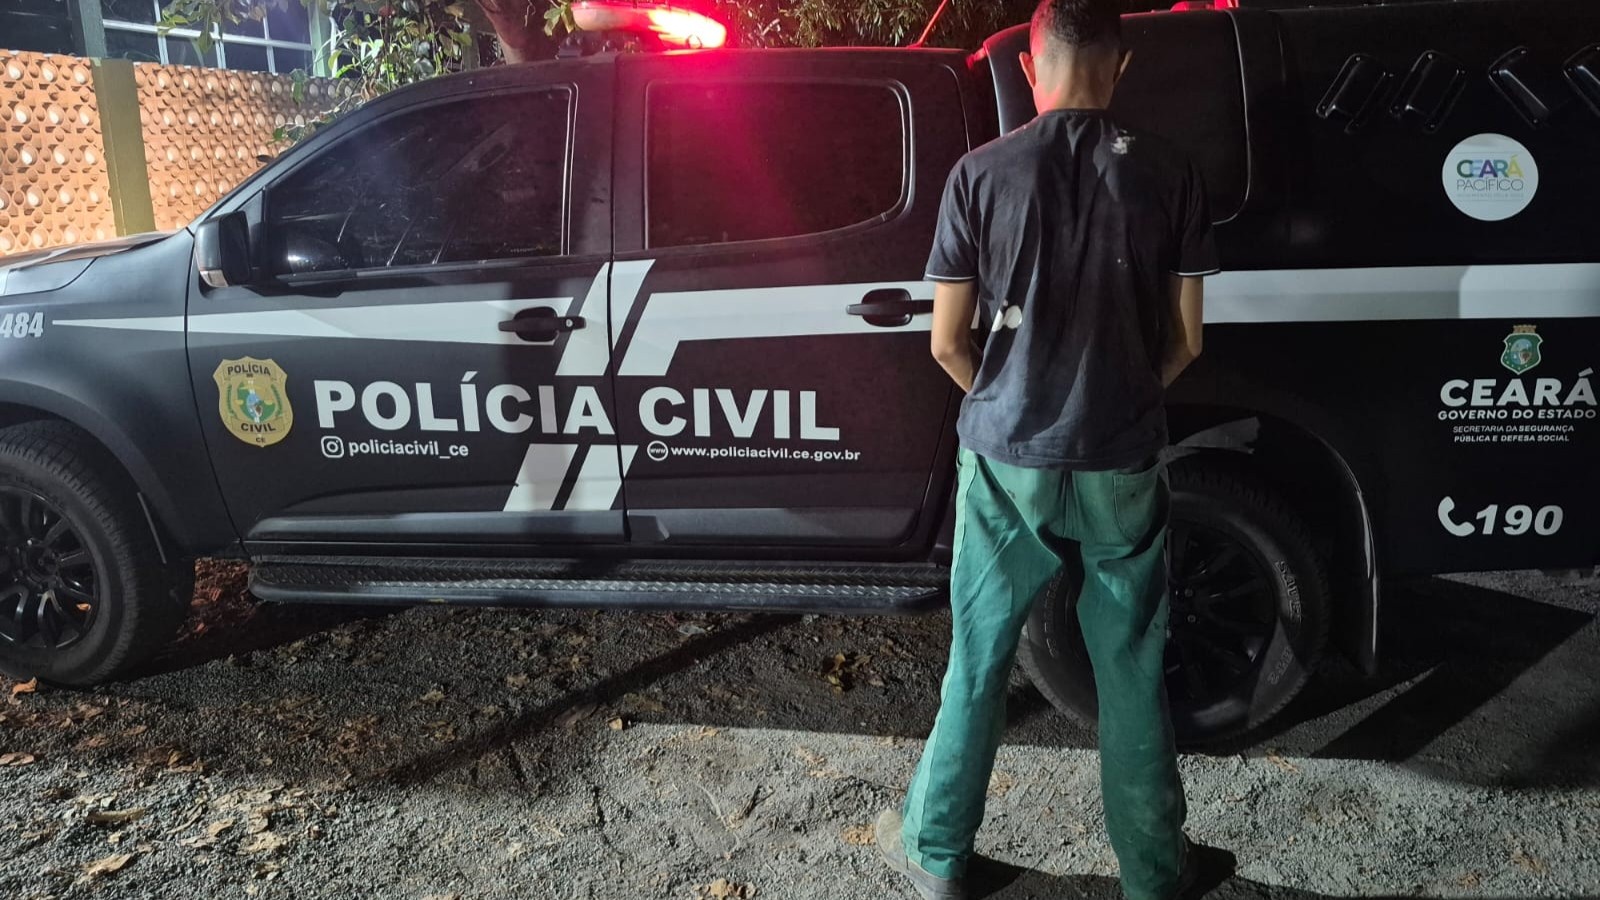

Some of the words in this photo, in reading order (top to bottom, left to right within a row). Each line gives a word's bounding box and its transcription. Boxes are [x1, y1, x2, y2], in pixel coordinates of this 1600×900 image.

[1456, 154, 1525, 178] CEARÁ
[1456, 177, 1524, 191] PACÍFICO
[0, 312, 44, 338] 484
[227, 362, 271, 376] POLÍCIA
[1440, 367, 1598, 407] CEARÁ
[314, 371, 615, 435] POLÍCIA
[638, 386, 840, 441] CIVIL
[1437, 409, 1508, 420] GOVERNO
[1512, 409, 1534, 419] DO
[1538, 408, 1597, 419] ESTADO
[240, 422, 277, 433] CIVIL
[1453, 425, 1504, 433] SECRETARIA
[1519, 424, 1575, 433] SEGURANÇA
[1454, 434, 1491, 443] PÚBLICA
[1500, 434, 1536, 442] DEFESA
[1537, 434, 1570, 442] SOCIAL
[348, 439, 469, 459] policiacivil_ce
[671, 446, 861, 461] www.policiacivil.ce.gov.br
[1476, 504, 1564, 536] 190
